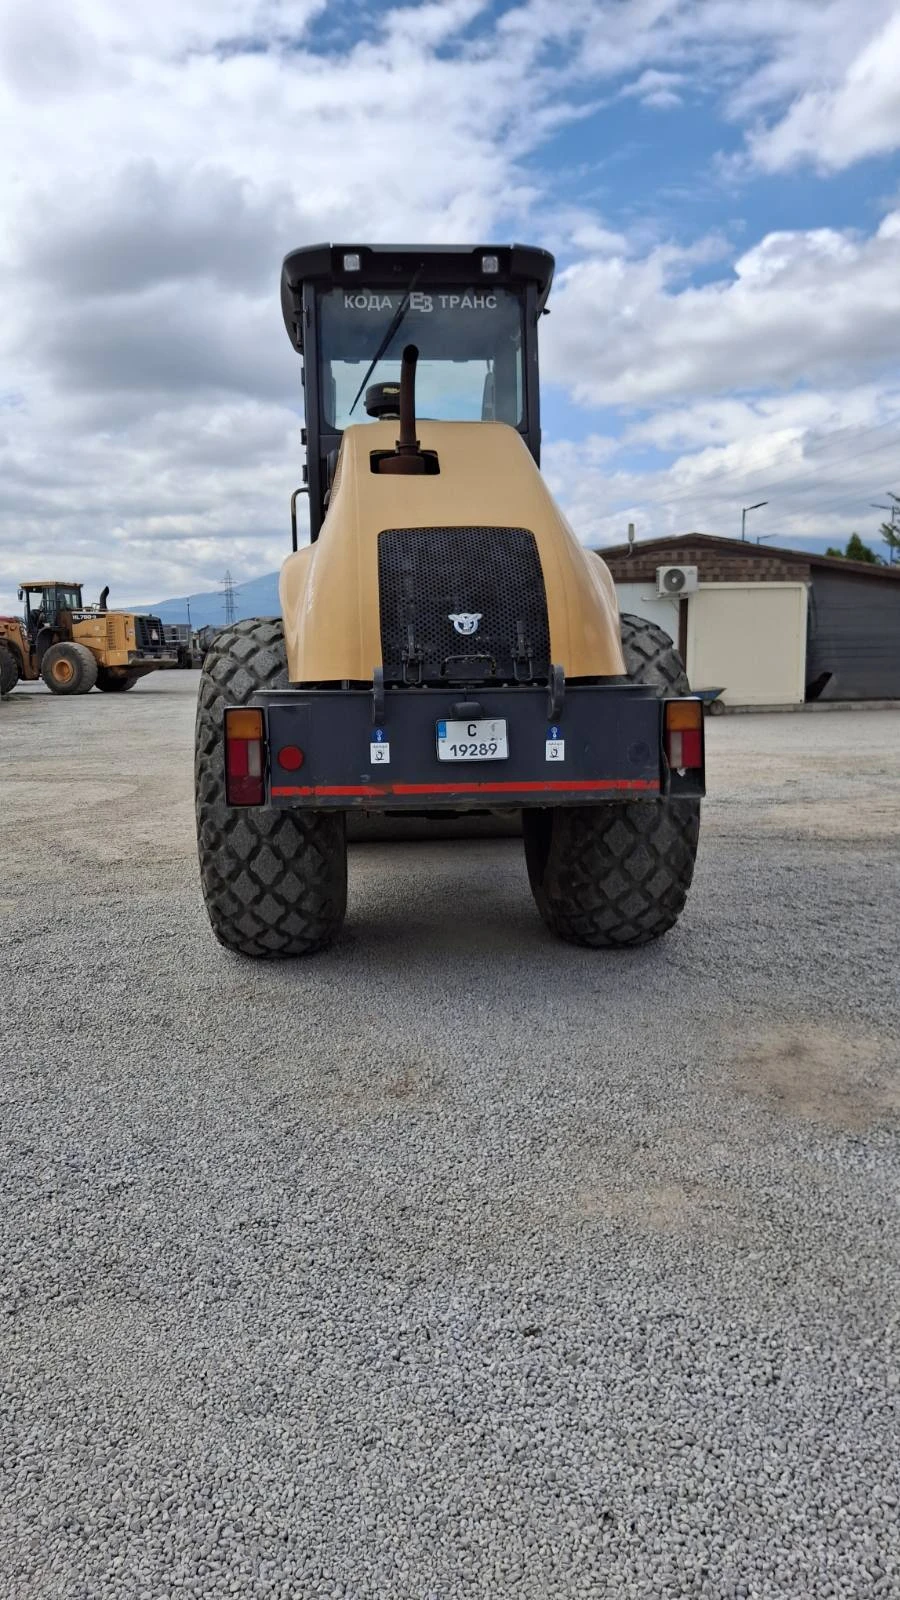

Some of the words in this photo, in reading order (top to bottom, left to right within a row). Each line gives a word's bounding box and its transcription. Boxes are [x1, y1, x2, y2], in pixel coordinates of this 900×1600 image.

[344, 295, 393, 311] КОДА
[438, 295, 497, 309] ТРАНС
[467, 723, 478, 737] C
[449, 742, 498, 757] 19289
